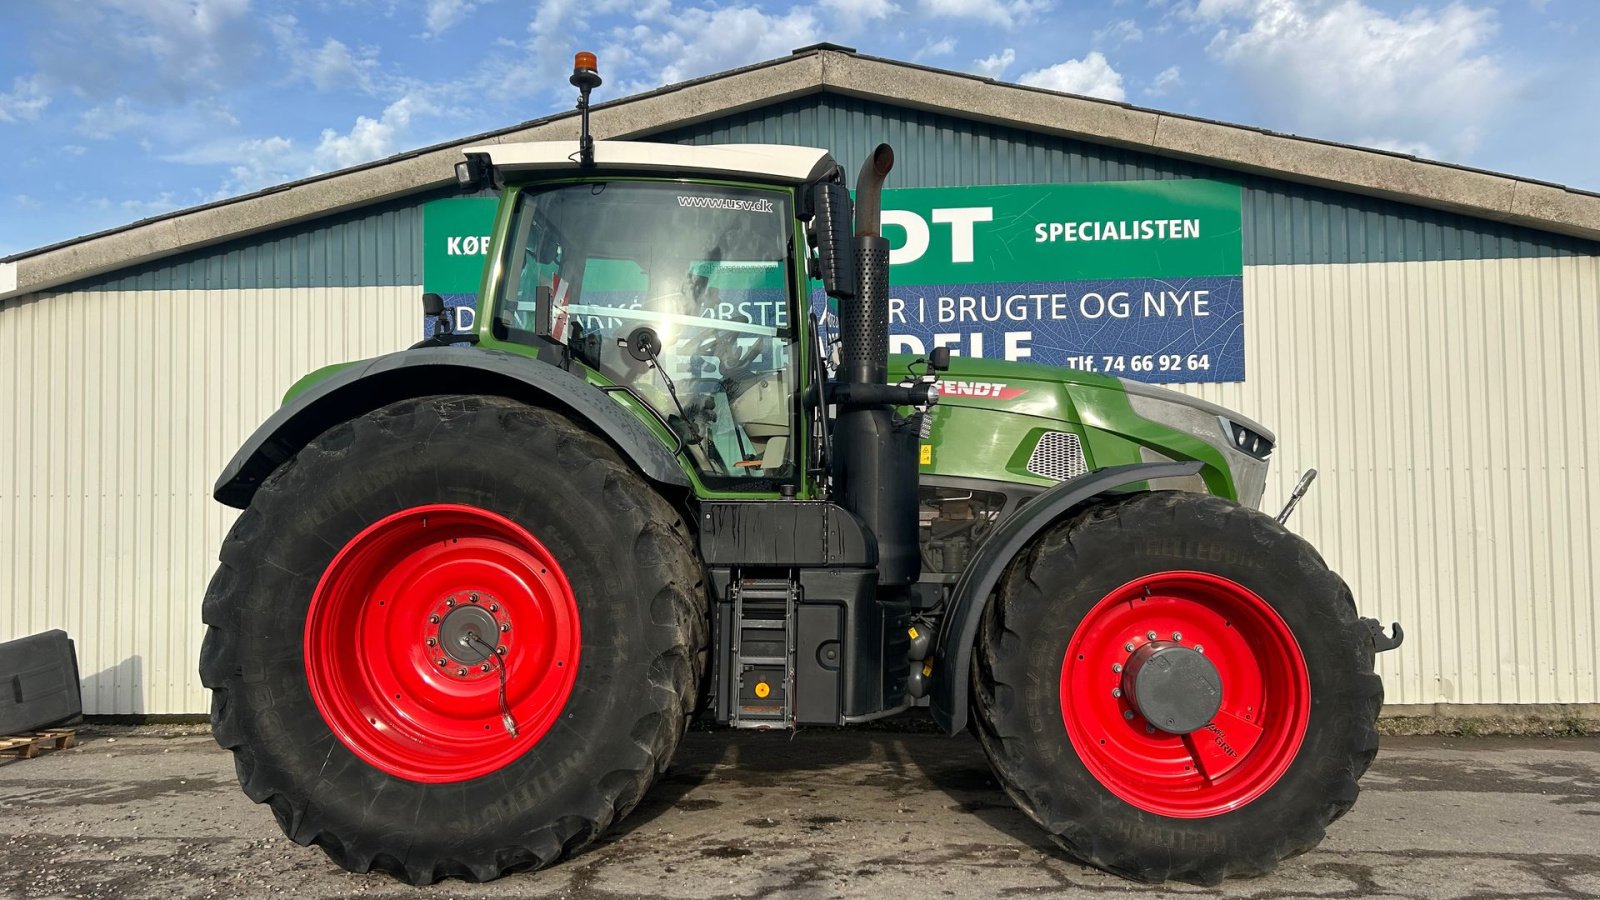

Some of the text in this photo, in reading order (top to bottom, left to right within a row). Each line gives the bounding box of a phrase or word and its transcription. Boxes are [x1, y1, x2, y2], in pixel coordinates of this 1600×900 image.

[677, 196, 773, 213] www.usv.dk
[1035, 219, 1200, 243] SPECIALISTEN
[938, 293, 1067, 323] BRUGTE
[1080, 292, 1130, 319] OG
[1144, 291, 1210, 318] NYE
[1067, 354, 1210, 372] Tlf. 74 66 92 64
[1214, 736, 1238, 758] GRIP
